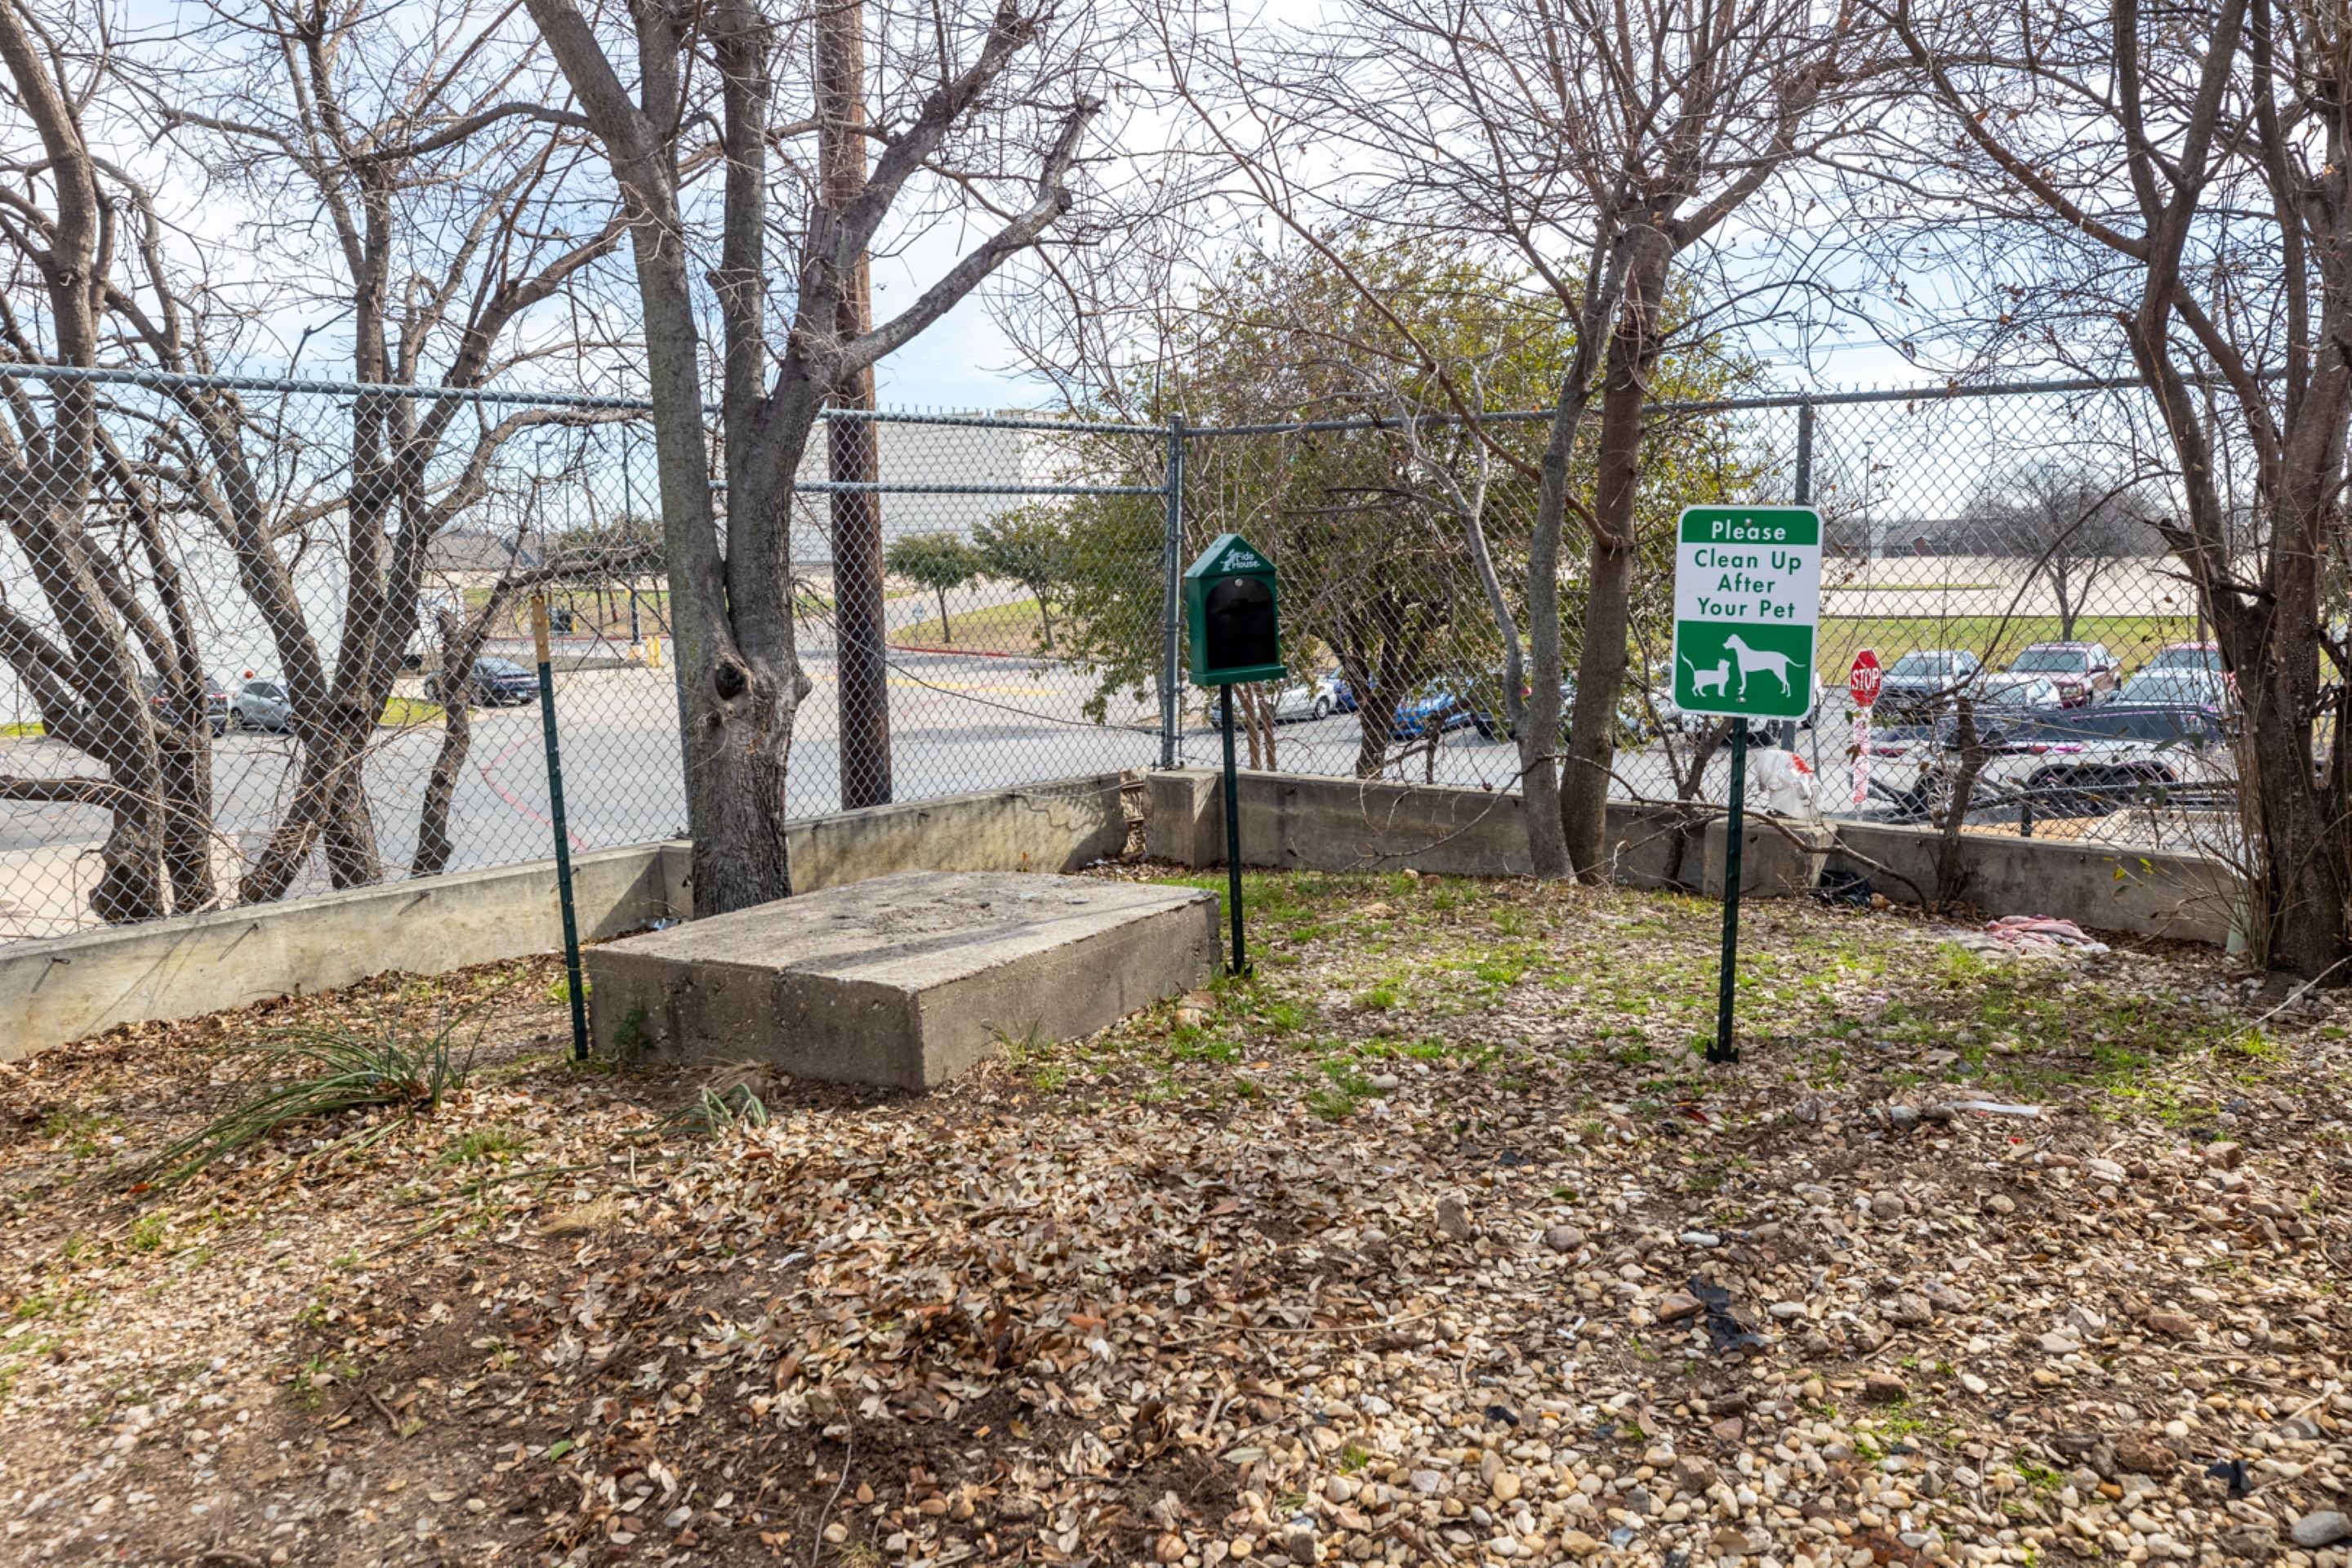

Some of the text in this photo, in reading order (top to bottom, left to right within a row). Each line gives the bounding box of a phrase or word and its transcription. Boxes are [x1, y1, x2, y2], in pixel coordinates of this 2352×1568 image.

[1711, 519, 1786, 541] Please
[1235, 551, 1255, 562] Fido
[1695, 549, 1802, 575] Clean Up
[1717, 572, 1775, 593] After
[1697, 597, 1795, 618] Your Pet
[1851, 668, 1880, 690] STOP
